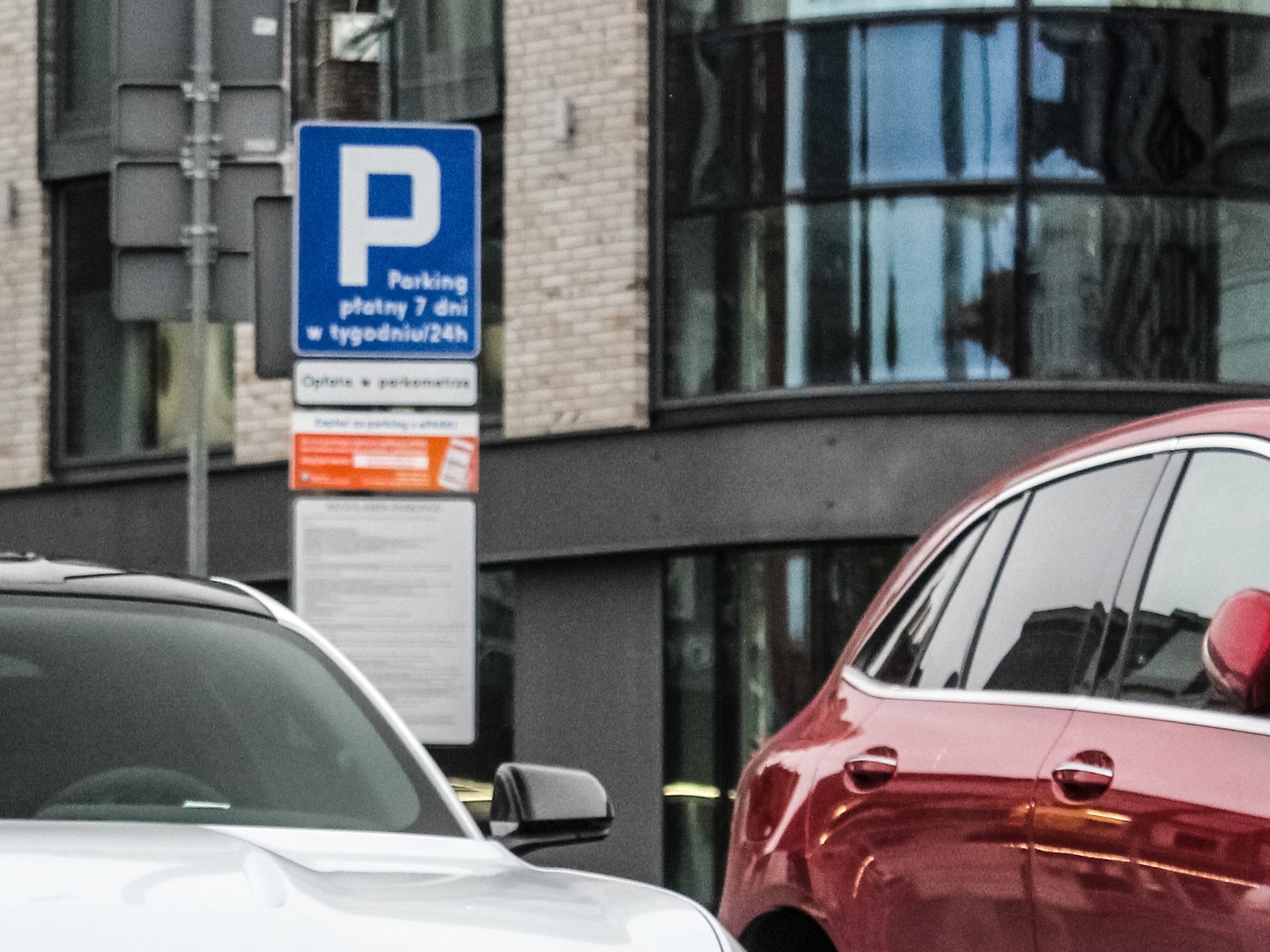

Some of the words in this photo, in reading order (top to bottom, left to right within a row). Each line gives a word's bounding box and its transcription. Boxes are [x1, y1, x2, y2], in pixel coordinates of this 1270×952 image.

[338, 144, 442, 288] P
[387, 268, 469, 296] Parking
[338, 296, 408, 321] płatny
[414, 296, 428, 317] 7
[433, 297, 469, 318] dni
[306, 325, 324, 341] w
[330, 321, 469, 347] tygodniu/24h
